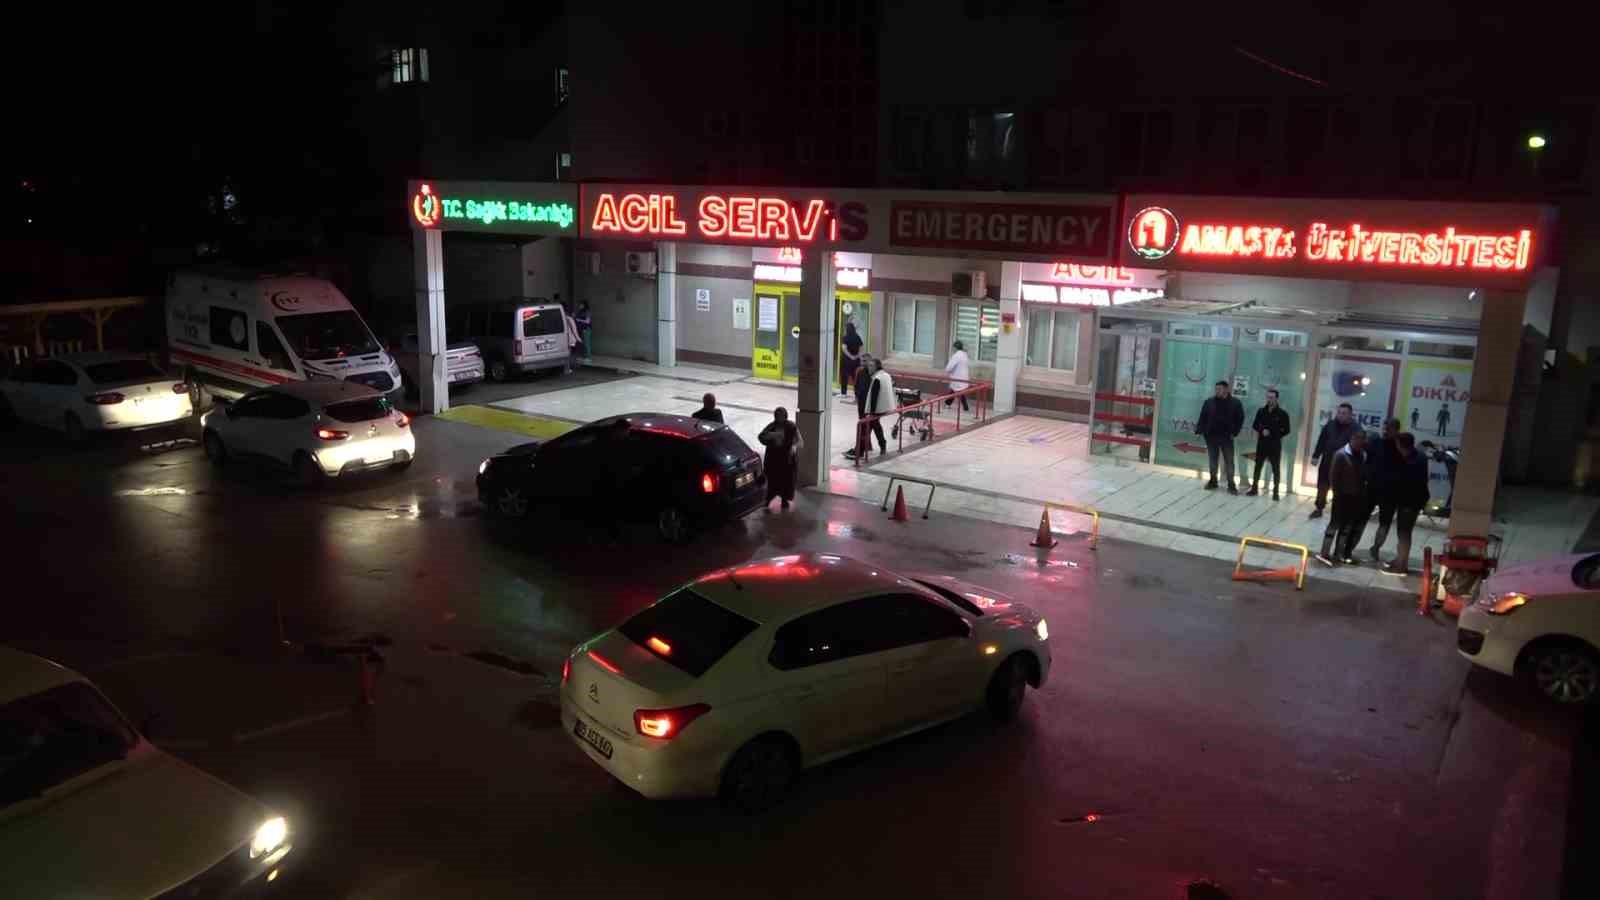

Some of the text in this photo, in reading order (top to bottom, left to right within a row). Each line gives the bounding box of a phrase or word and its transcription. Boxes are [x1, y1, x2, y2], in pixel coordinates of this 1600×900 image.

[442, 200, 463, 218] T.C.
[896, 208, 1102, 246] EMERGENCY
[1412, 384, 1472, 402] DİKKA
